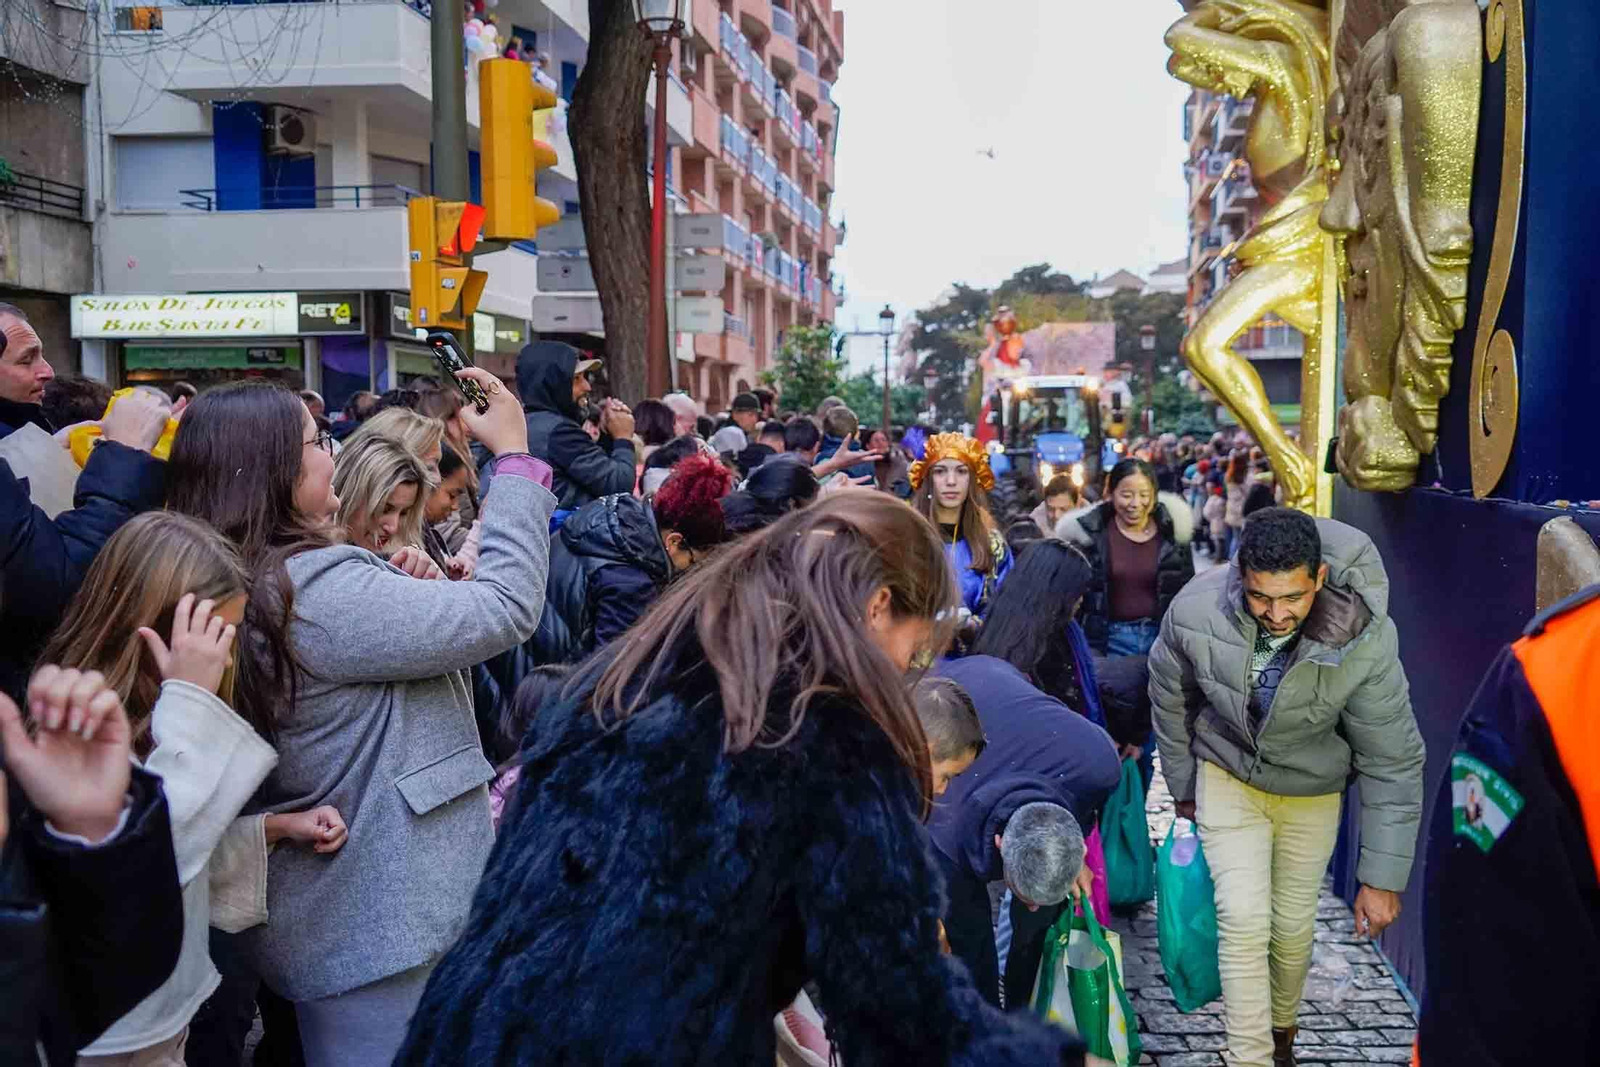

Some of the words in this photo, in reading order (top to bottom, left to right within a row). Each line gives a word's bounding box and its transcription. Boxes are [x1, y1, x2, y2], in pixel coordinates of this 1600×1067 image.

[157, 297, 193, 311] DE
[196, 297, 288, 311] JUEGOS
[102, 318, 152, 332] BAR
[155, 318, 230, 331] SANTA
